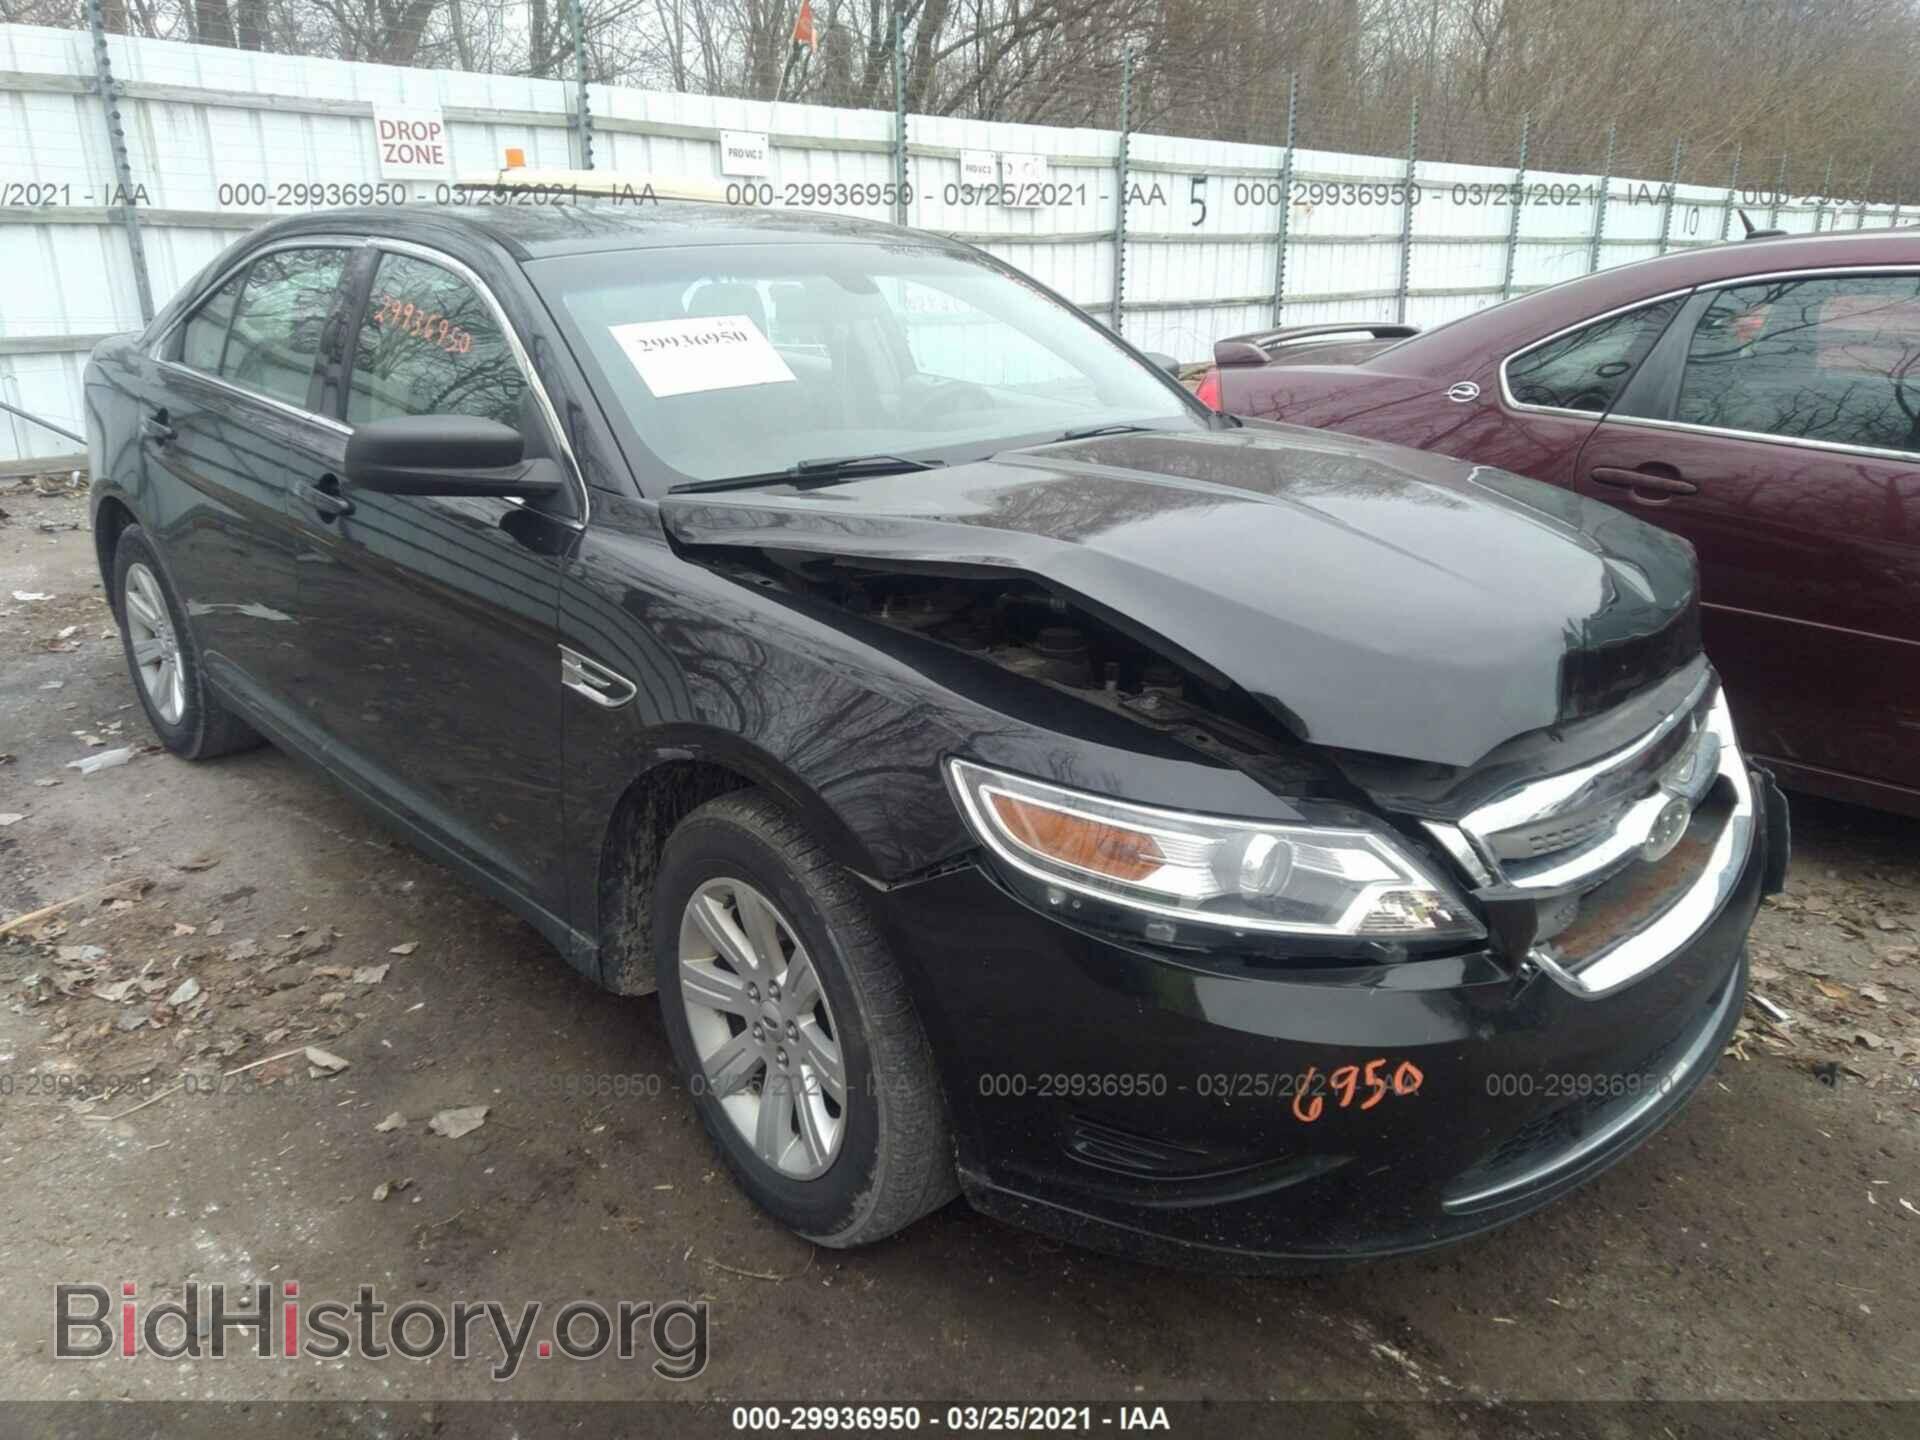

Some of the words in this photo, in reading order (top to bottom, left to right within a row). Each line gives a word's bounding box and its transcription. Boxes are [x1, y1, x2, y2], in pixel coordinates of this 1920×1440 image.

[379, 119, 442, 142] DROP
[383, 143, 445, 165] ZONE
[1190, 176, 1208, 227] 5
[1685, 207, 1700, 236] 10
[637, 330, 749, 352] 29936950
[1292, 1057, 1425, 1123] 6950
